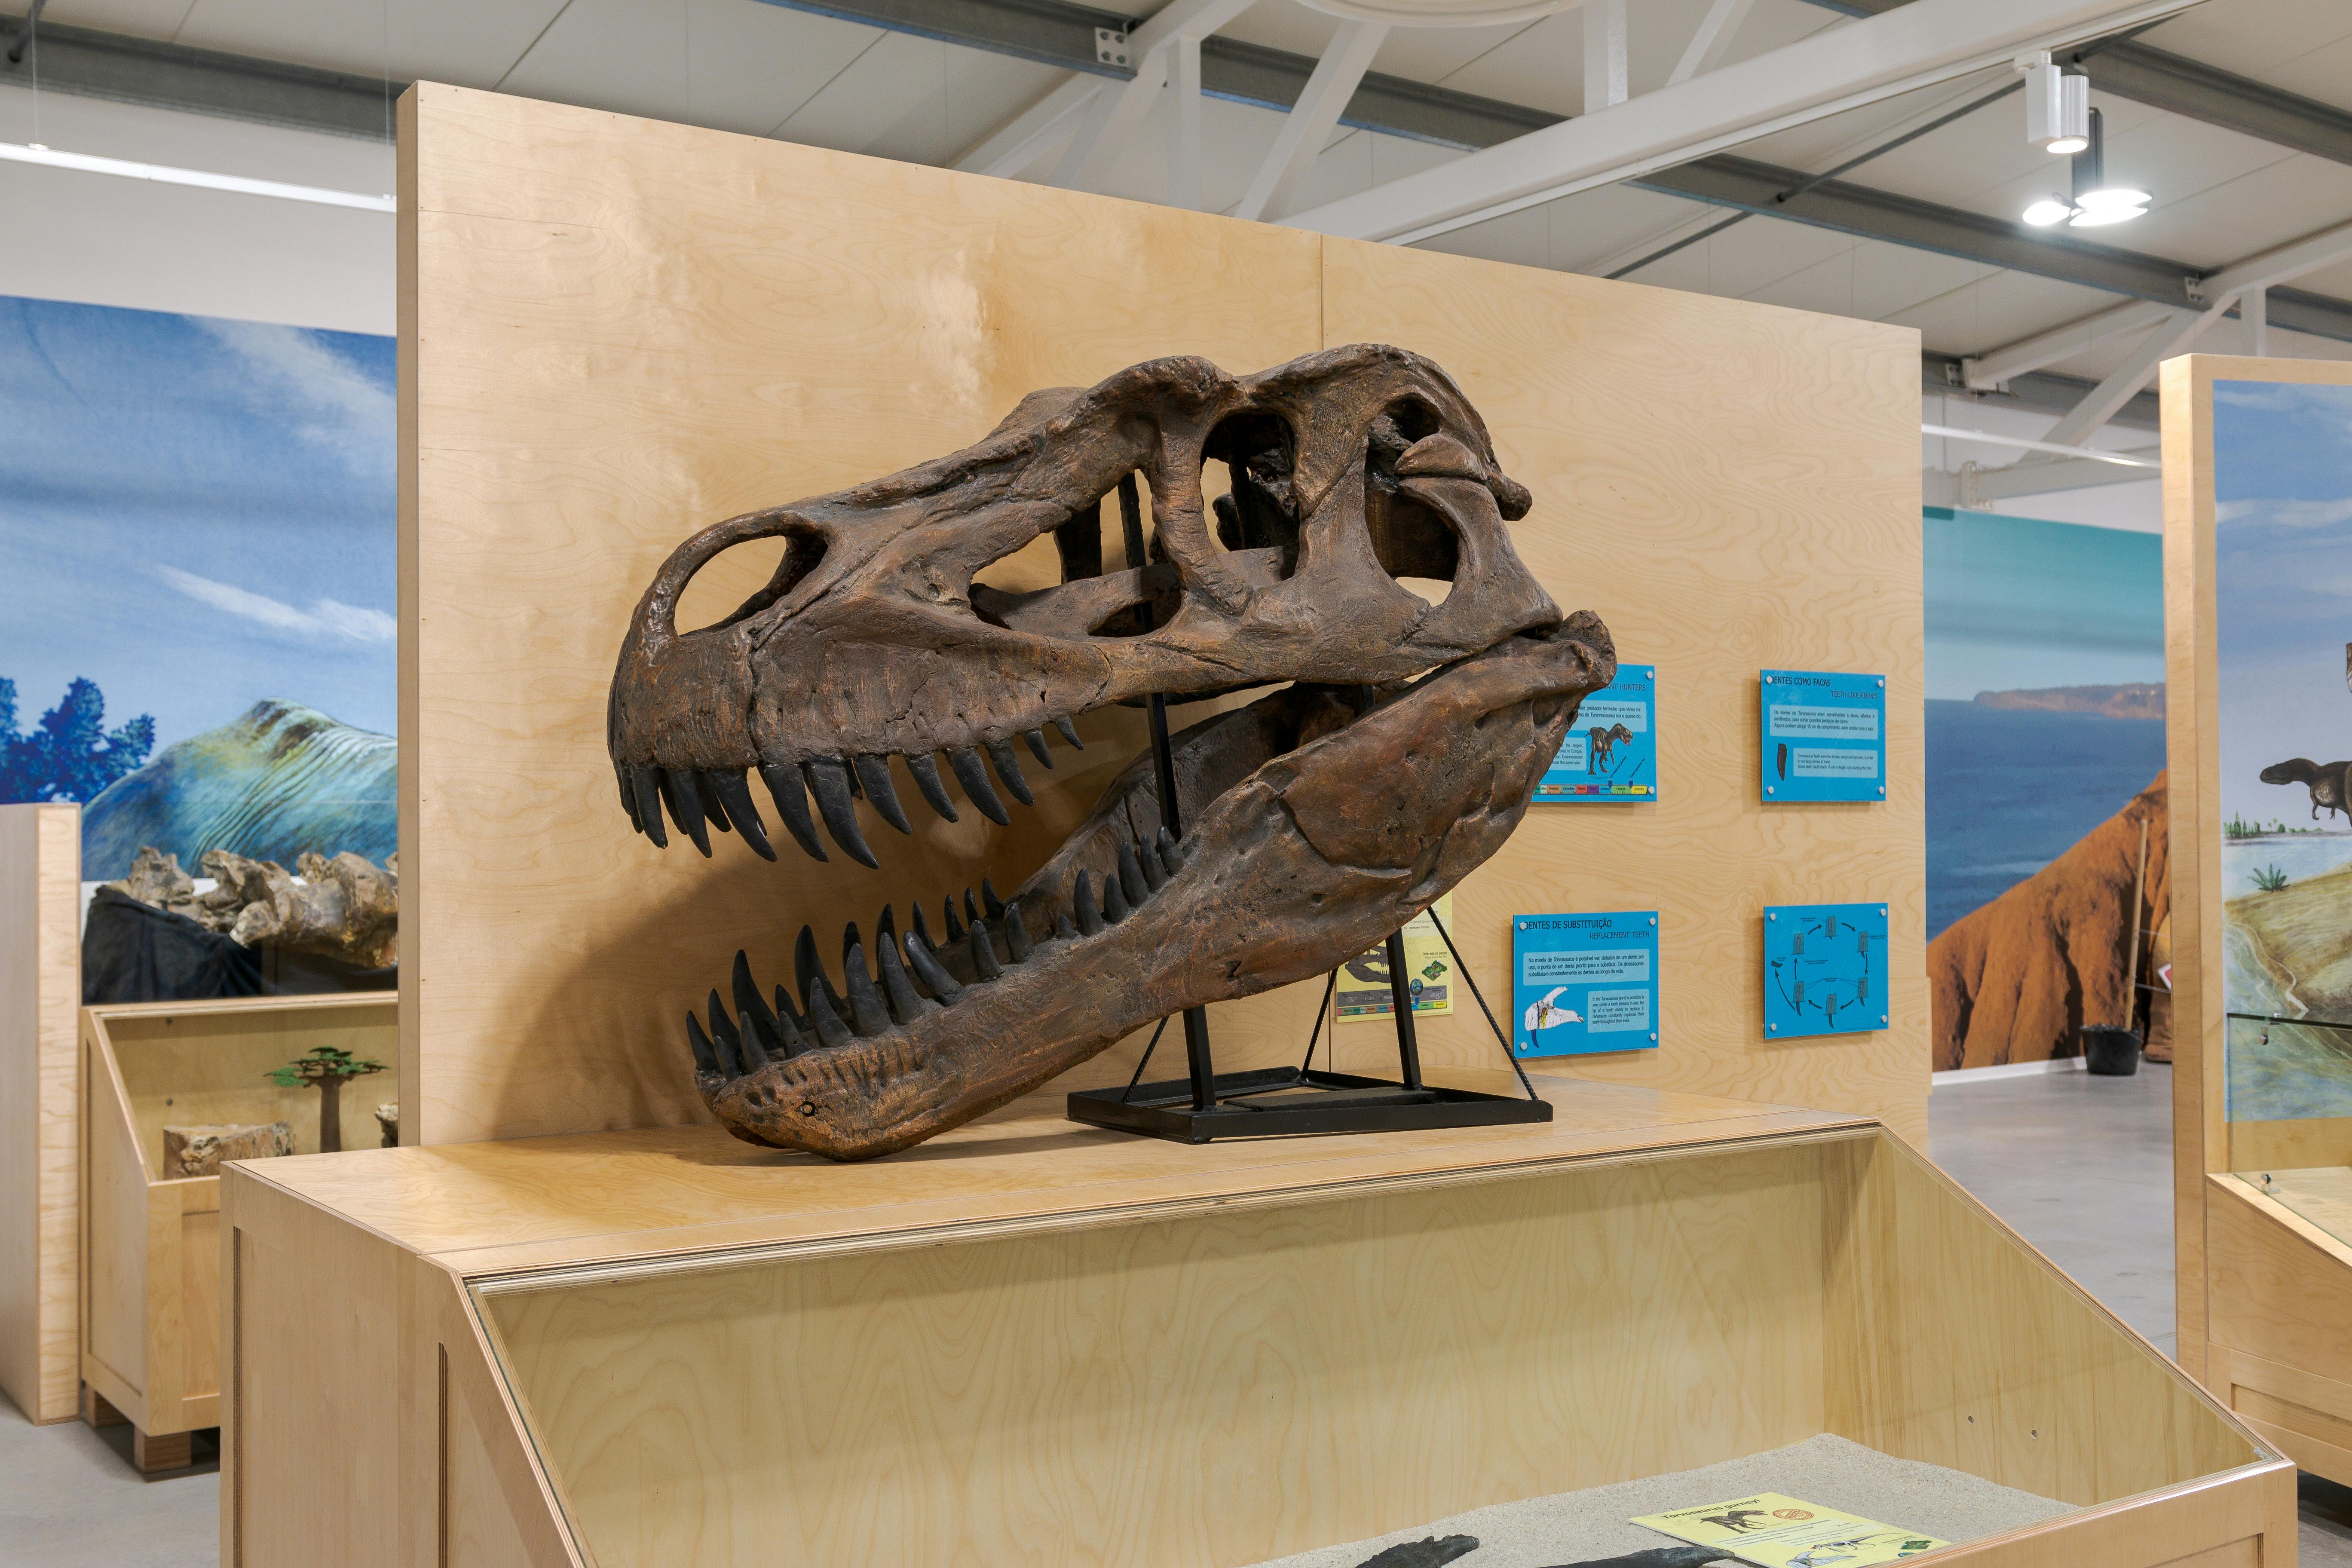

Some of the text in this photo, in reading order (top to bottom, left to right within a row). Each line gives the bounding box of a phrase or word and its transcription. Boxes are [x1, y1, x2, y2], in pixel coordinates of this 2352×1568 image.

[1795, 677, 1812, 686] COMO
[1813, 678, 1831, 686] FACAS
[1524, 921, 1550, 929] DENTES
[1564, 918, 1612, 929] SUBSTITUIÇÃO
[1661, 1498, 1761, 1519] Torvosaurus gurneyi
